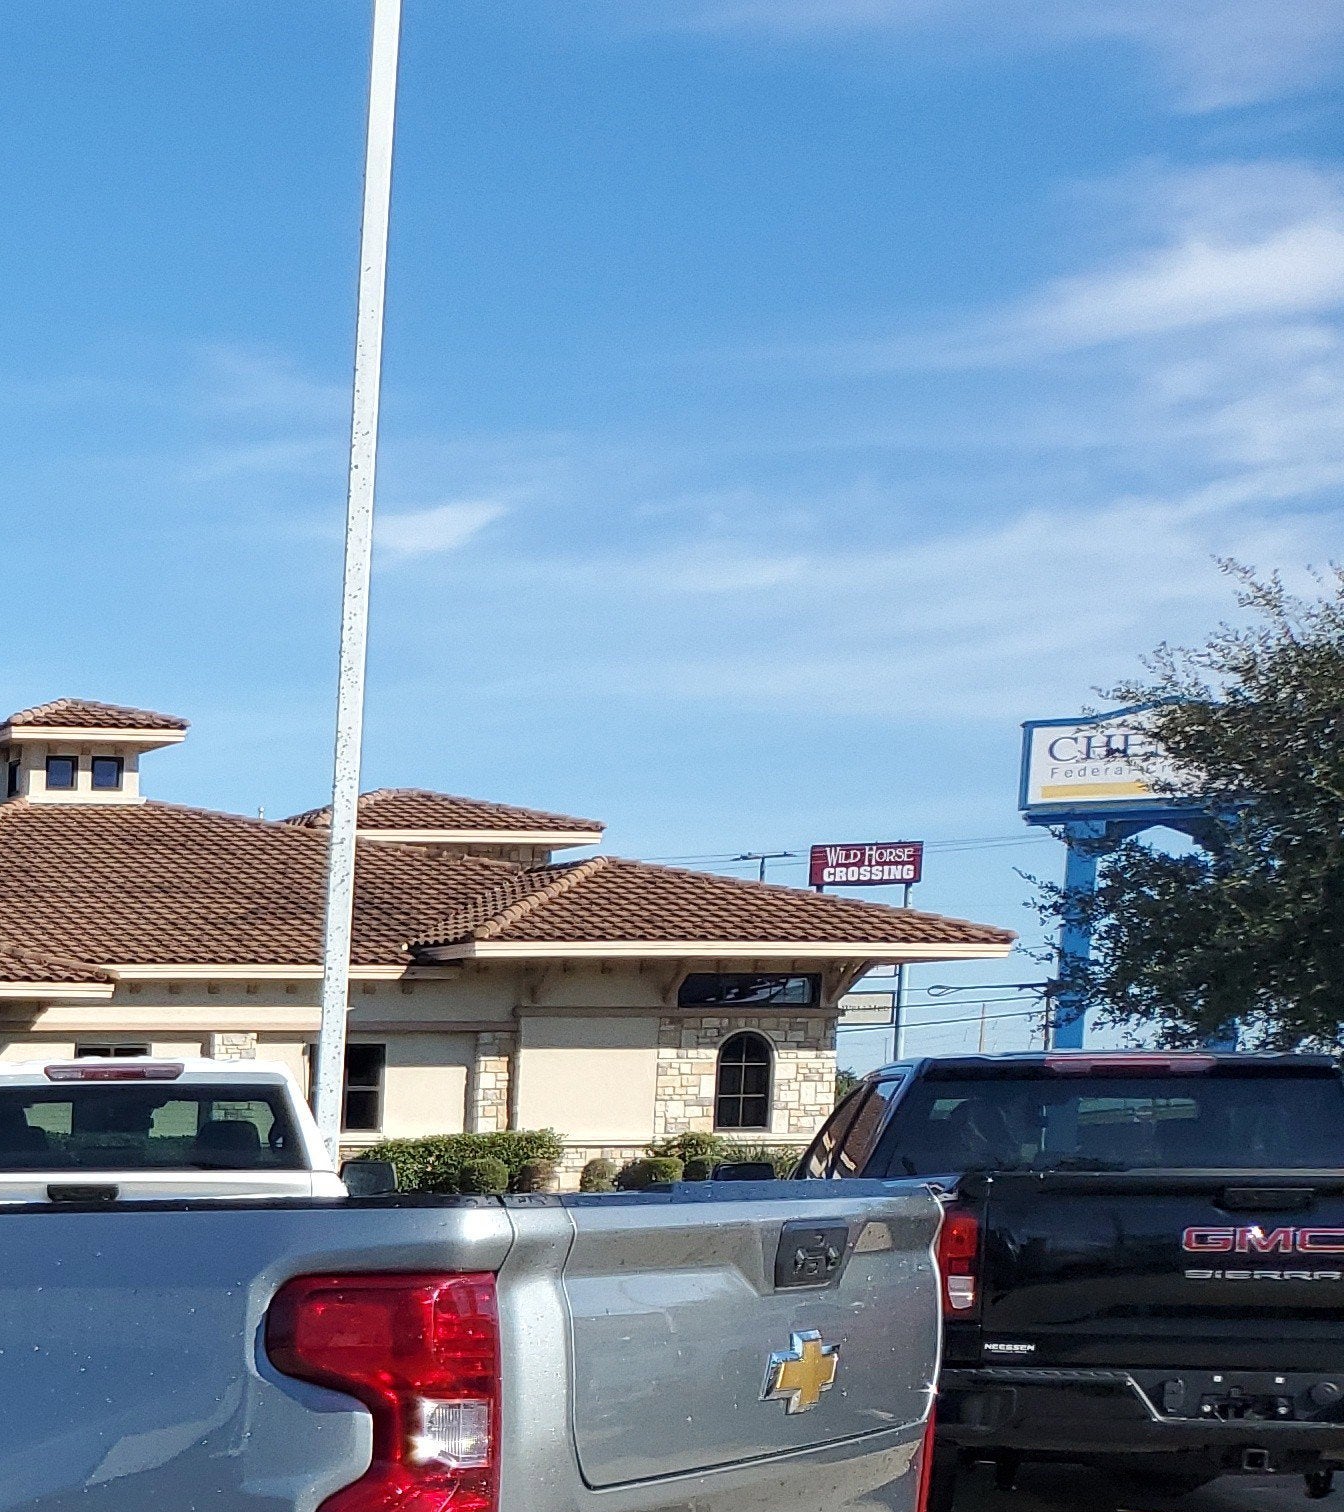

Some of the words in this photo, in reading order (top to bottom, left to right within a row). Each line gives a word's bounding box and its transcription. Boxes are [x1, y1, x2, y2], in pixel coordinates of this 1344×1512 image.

[825, 846, 861, 867] WILD
[864, 845, 914, 866] HORSE
[822, 864, 915, 883] CROSSING
[1182, 1226, 1344, 1254] GMC
[1184, 1269, 1343, 1281] SIERRA
